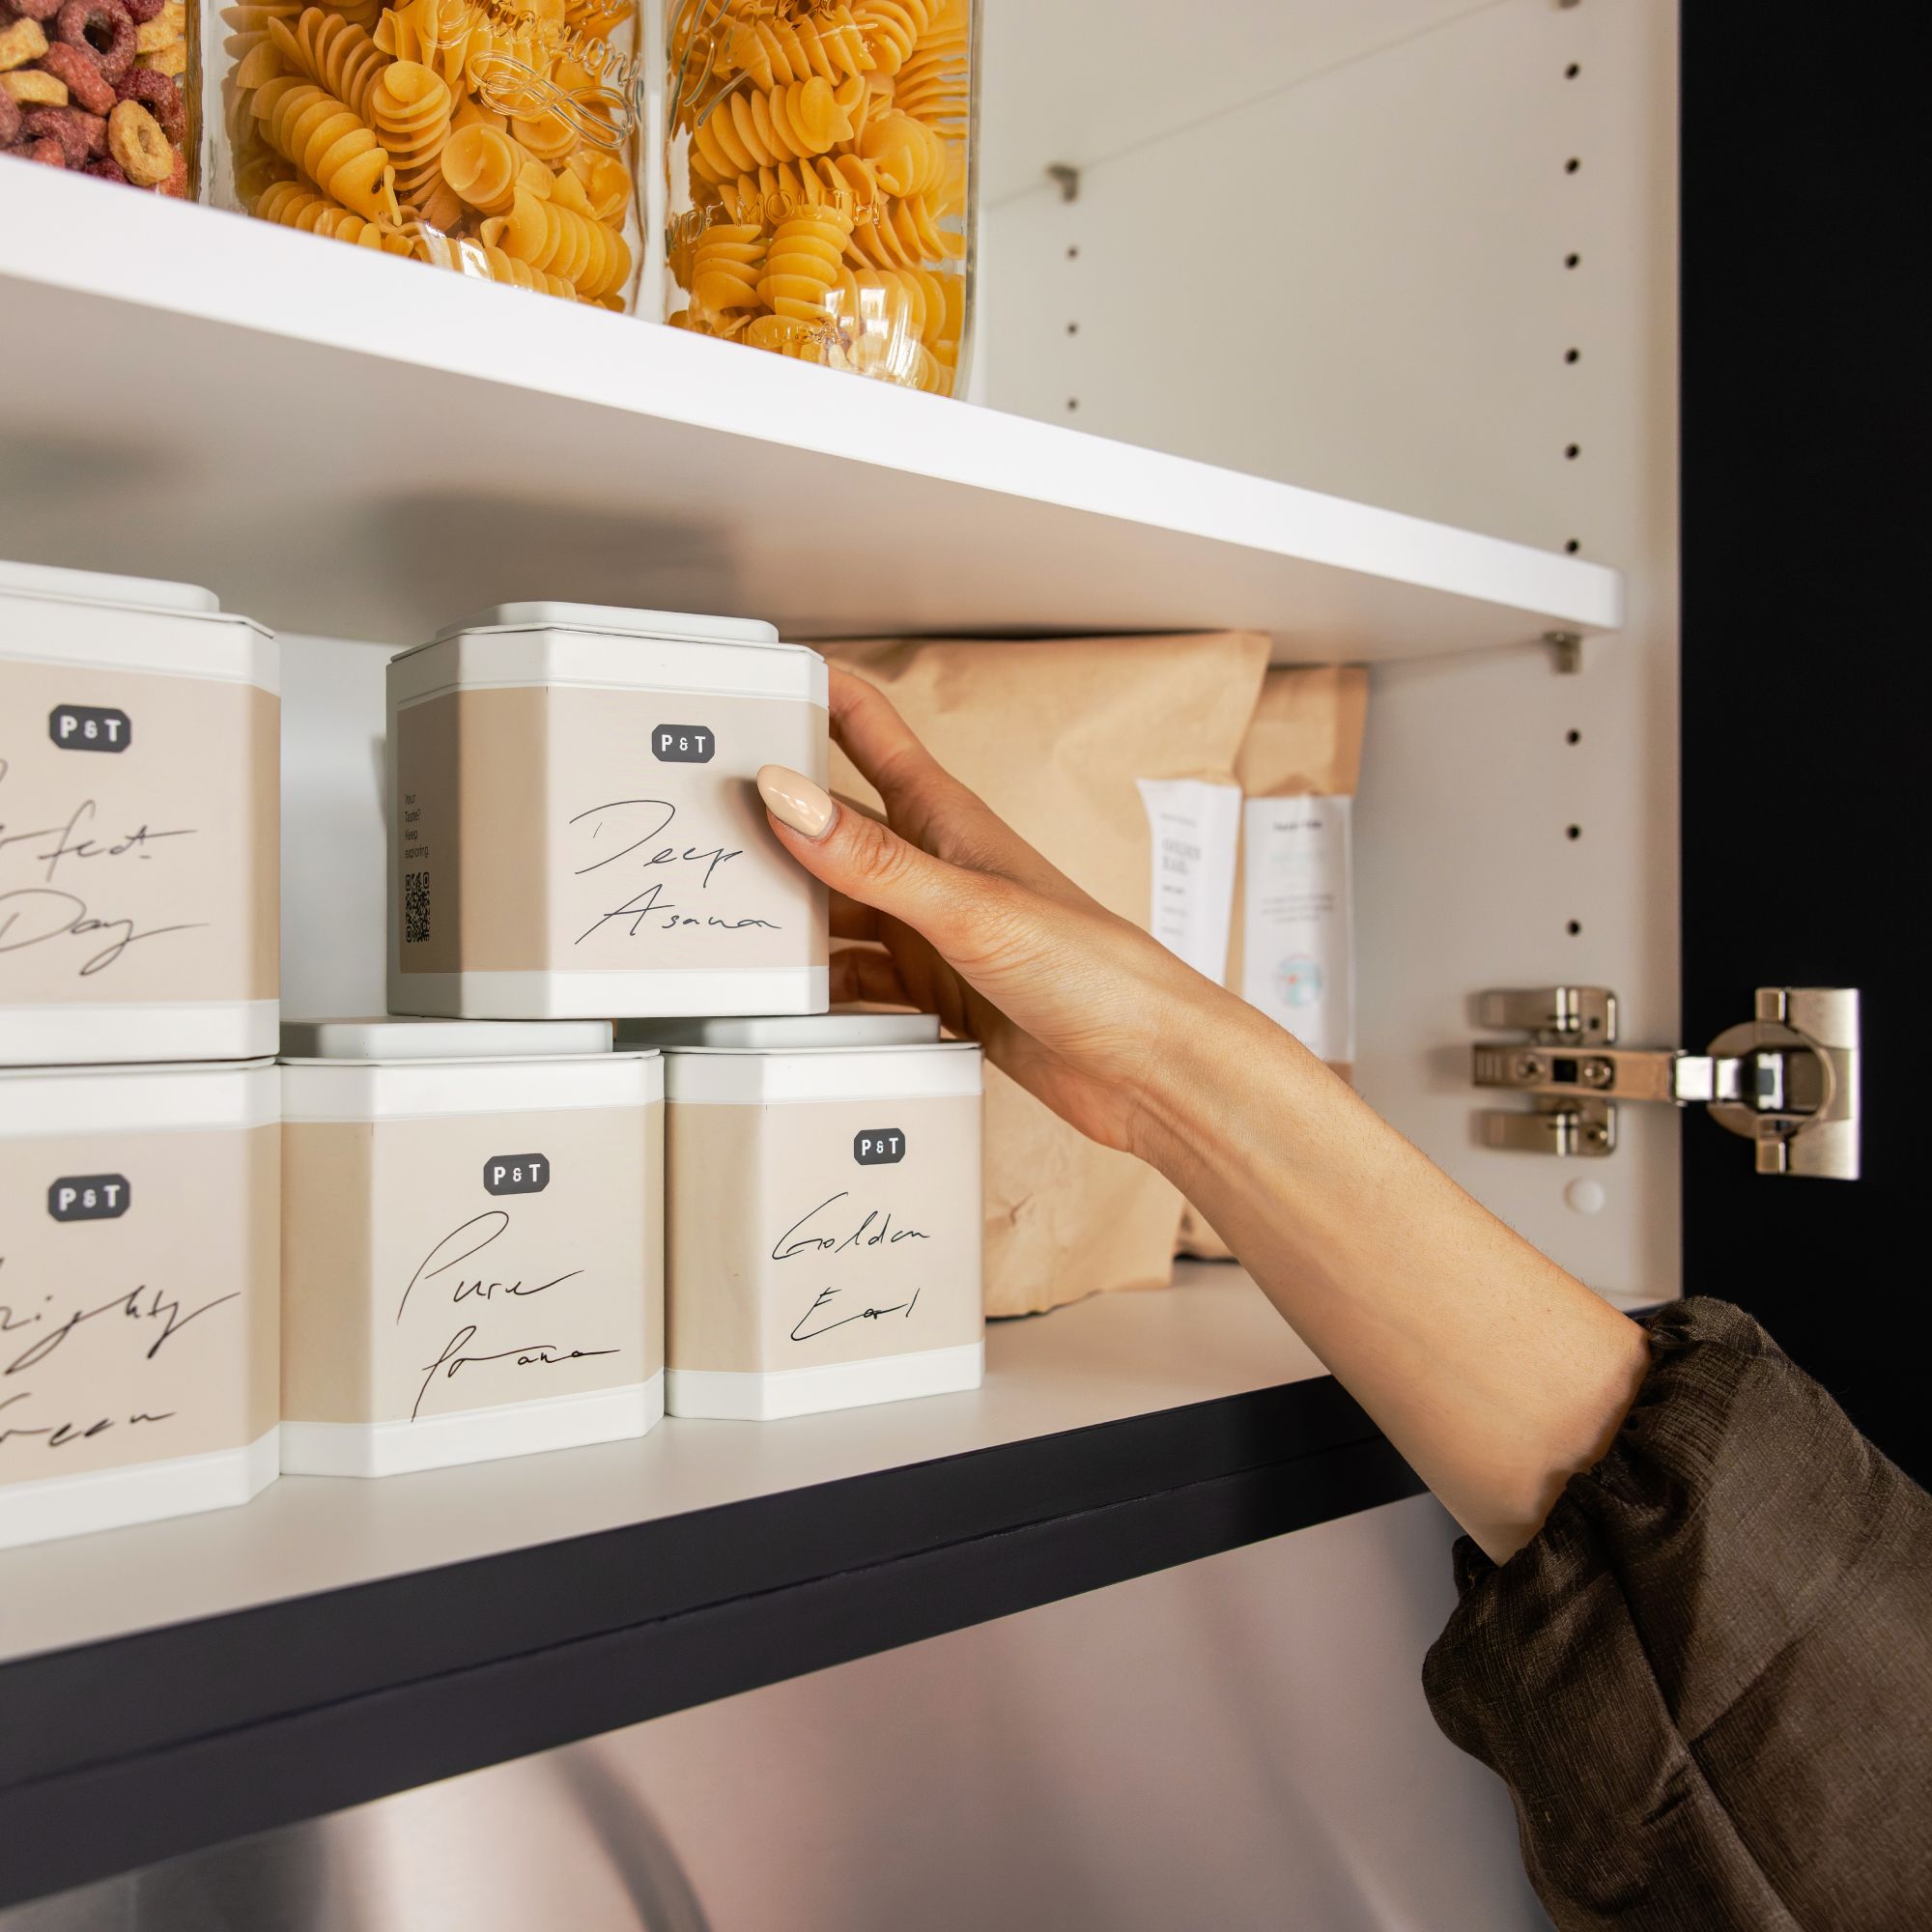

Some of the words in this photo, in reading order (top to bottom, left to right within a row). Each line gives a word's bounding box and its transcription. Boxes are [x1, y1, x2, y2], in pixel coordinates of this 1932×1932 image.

[569, 799, 744, 889] Deep
[574, 883, 783, 945] Asana
[772, 1191, 931, 1260] Golden
[396, 1210, 585, 1325] Pure
[790, 1287, 921, 1342] Earl
